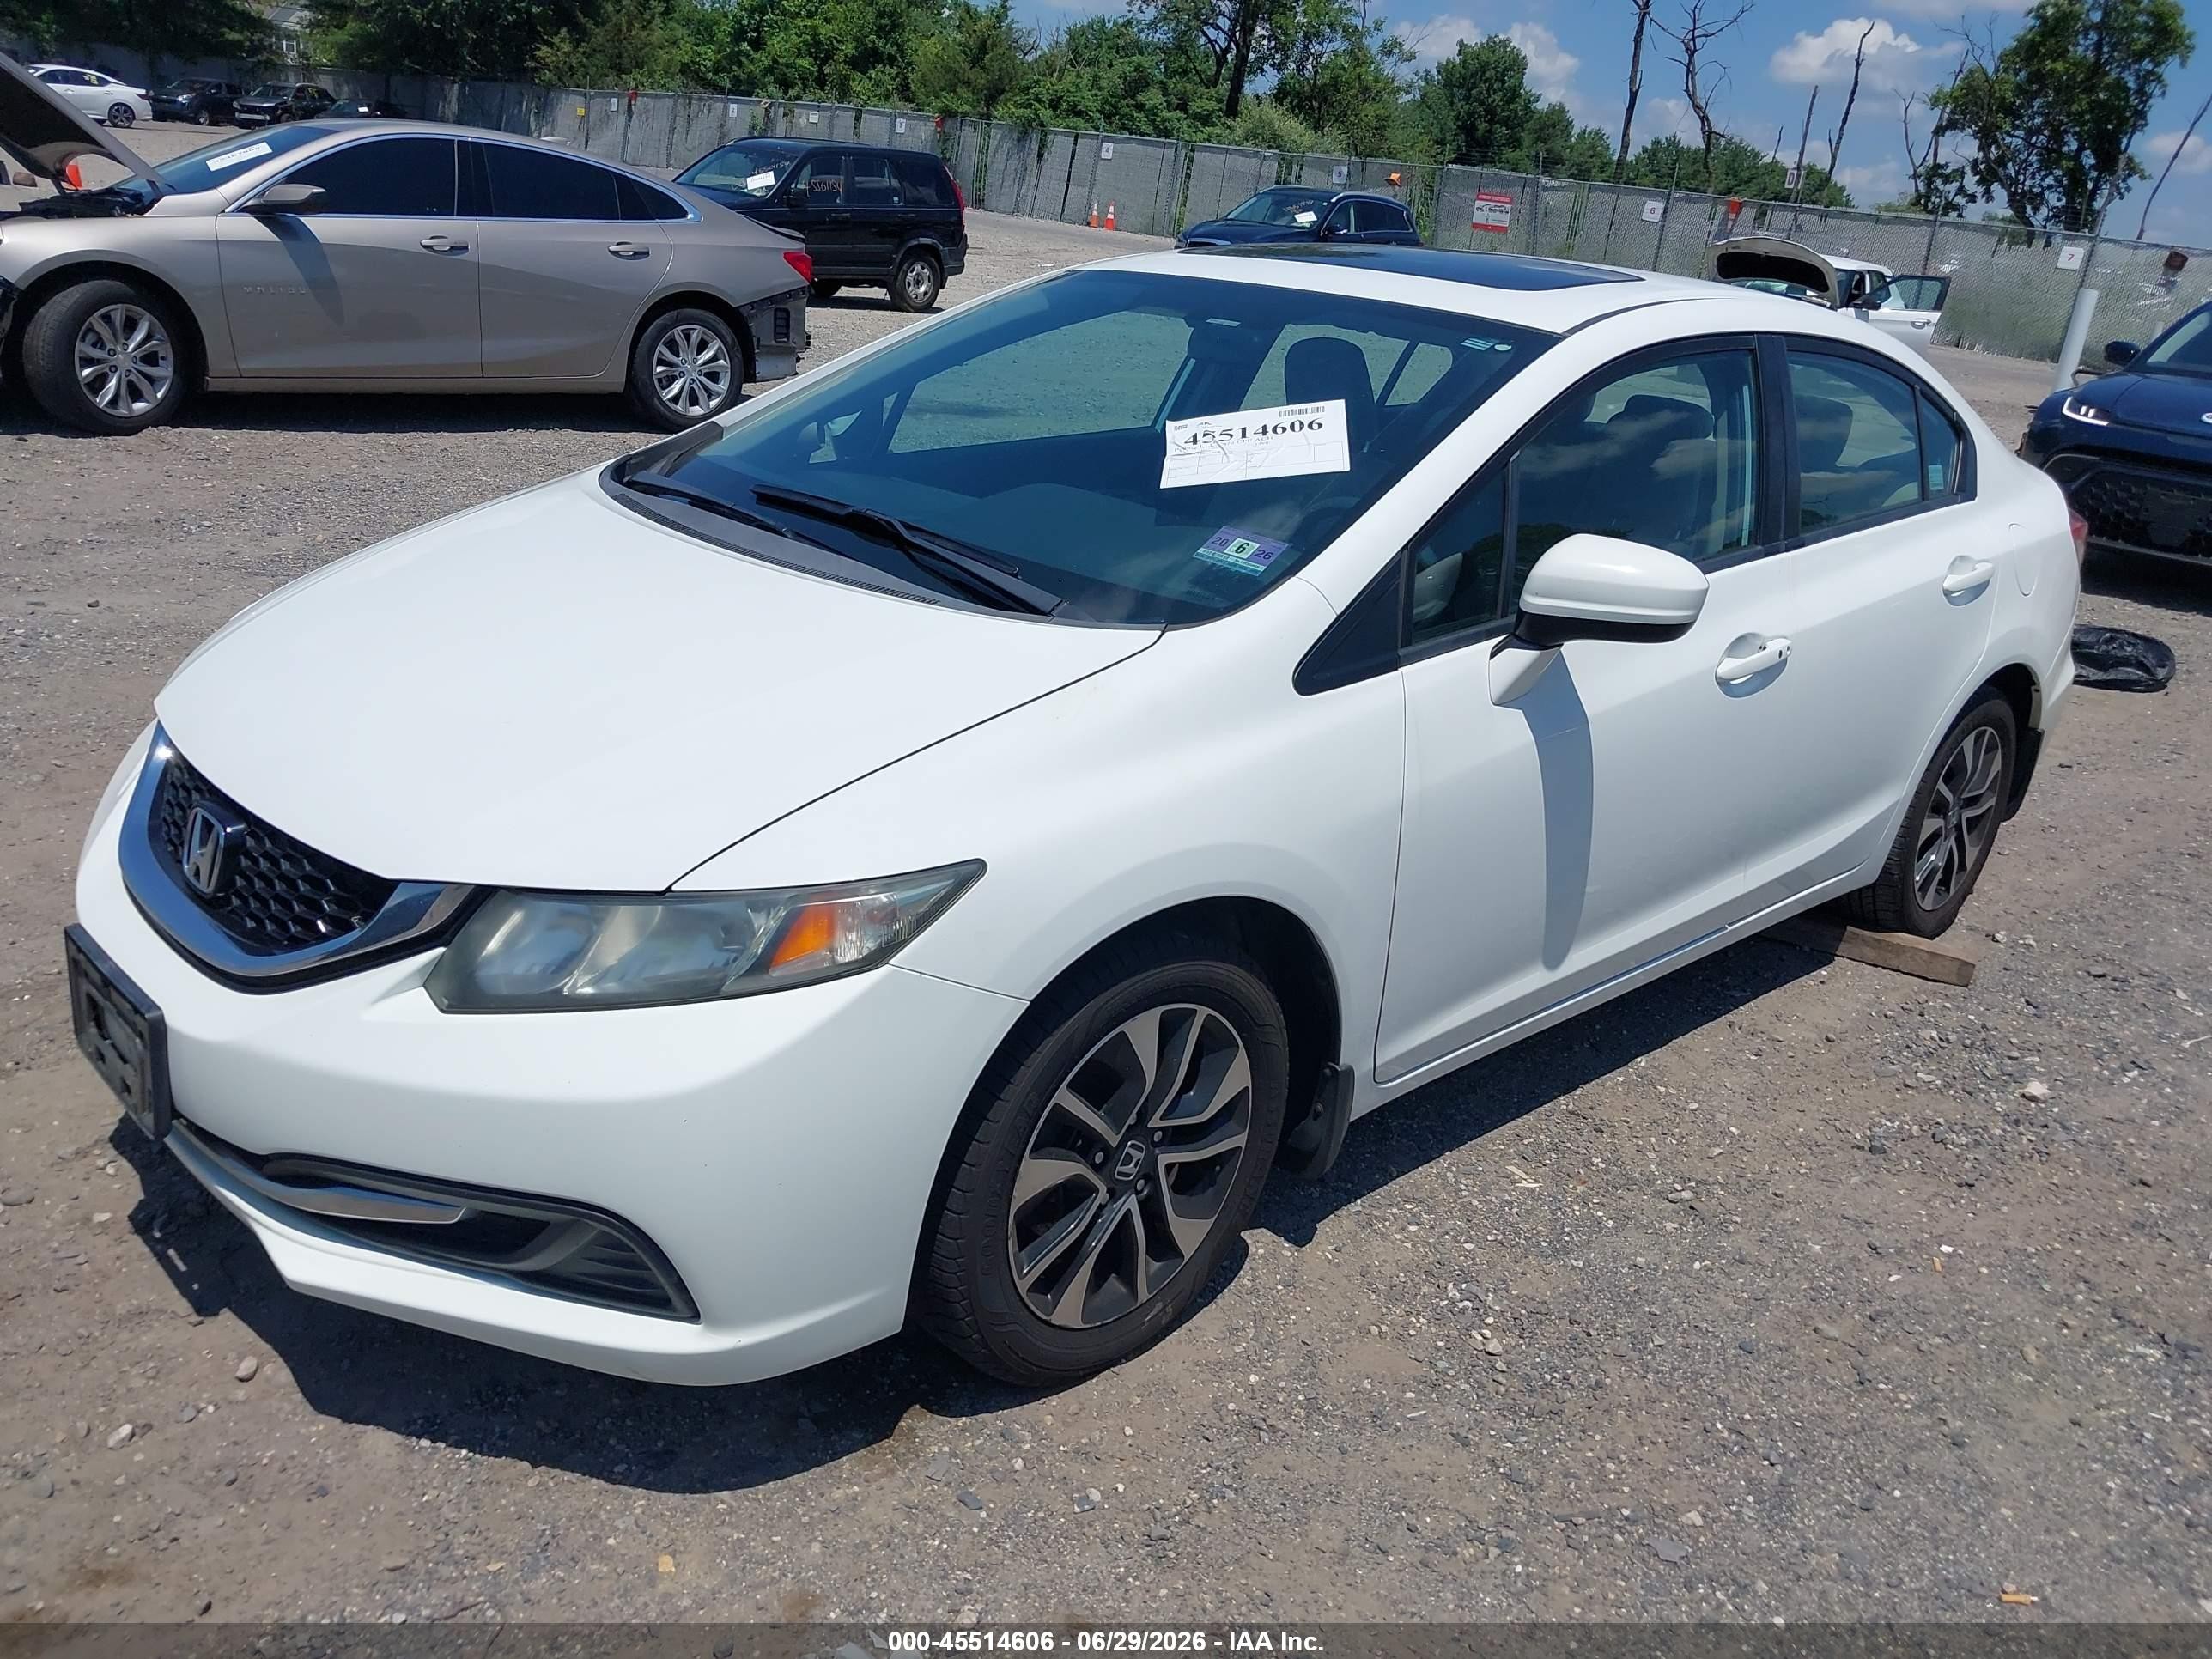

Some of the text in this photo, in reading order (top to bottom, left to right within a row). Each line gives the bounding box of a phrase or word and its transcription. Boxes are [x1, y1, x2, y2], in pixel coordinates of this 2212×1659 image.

[1184, 417, 1323, 446] 45514606
[1212, 537, 1273, 560] 20 6 26
